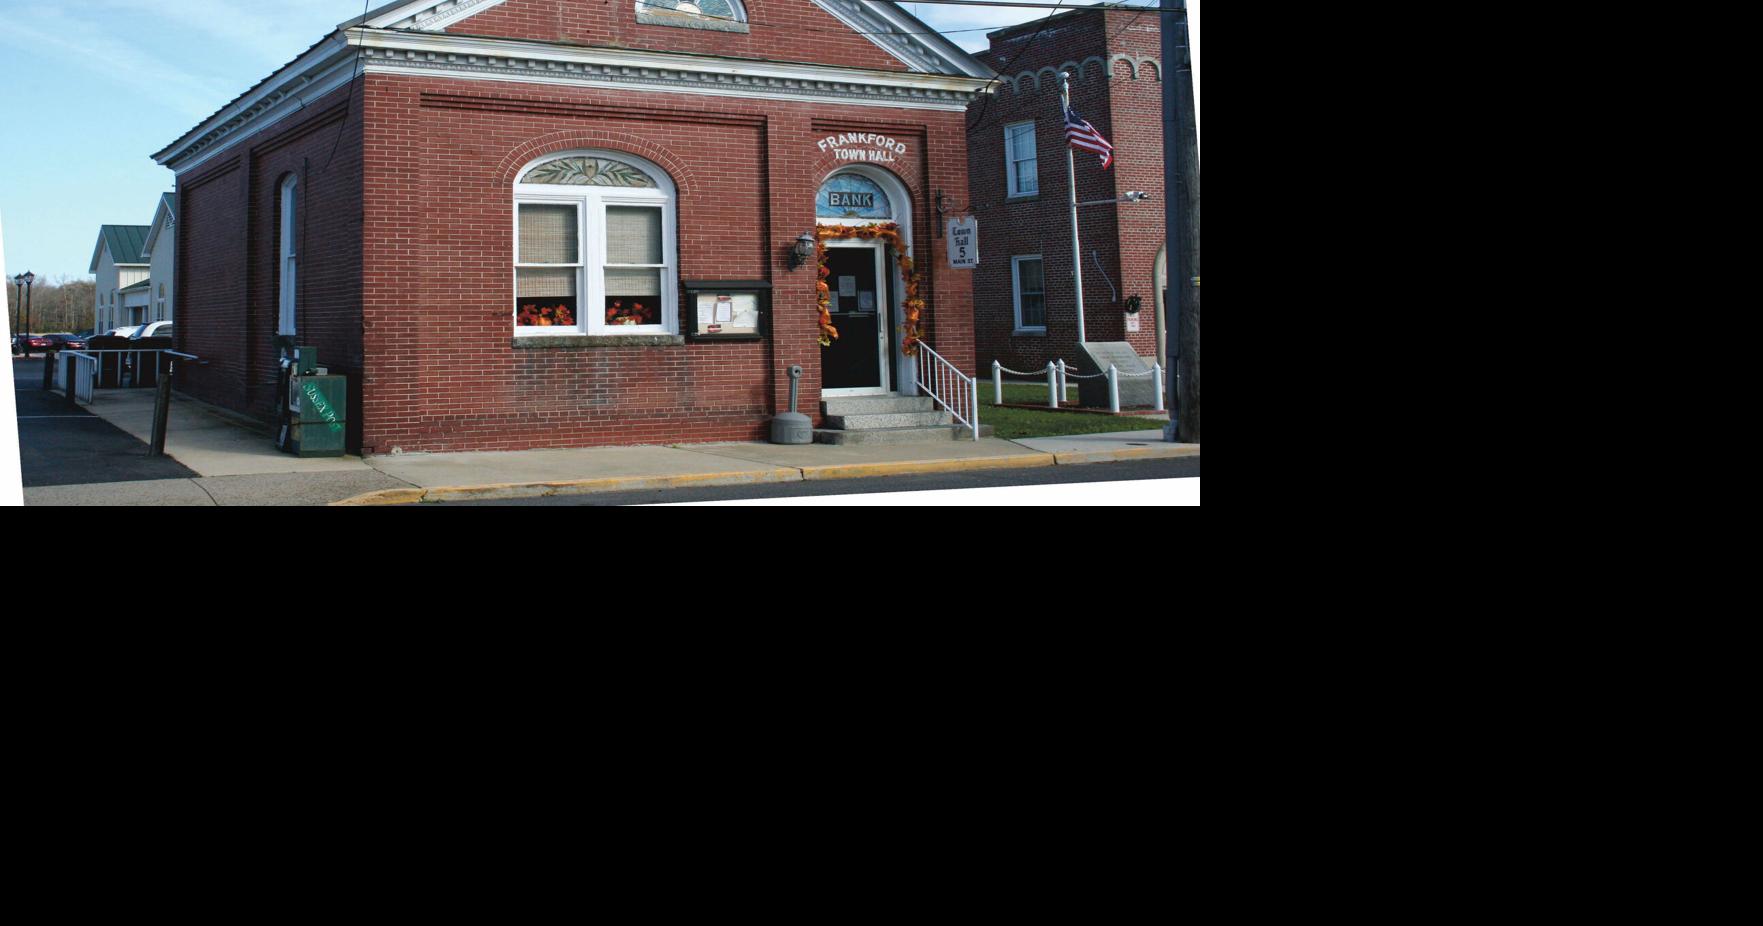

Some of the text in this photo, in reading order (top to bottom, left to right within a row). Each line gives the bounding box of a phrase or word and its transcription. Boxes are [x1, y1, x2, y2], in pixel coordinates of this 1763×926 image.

[817, 133, 906, 154] FRANKFORD
[833, 149, 896, 162] TOWN HALL
[830, 193, 873, 206] BANK
[952, 227, 971, 236] Town
[959, 247, 966, 258] 5
